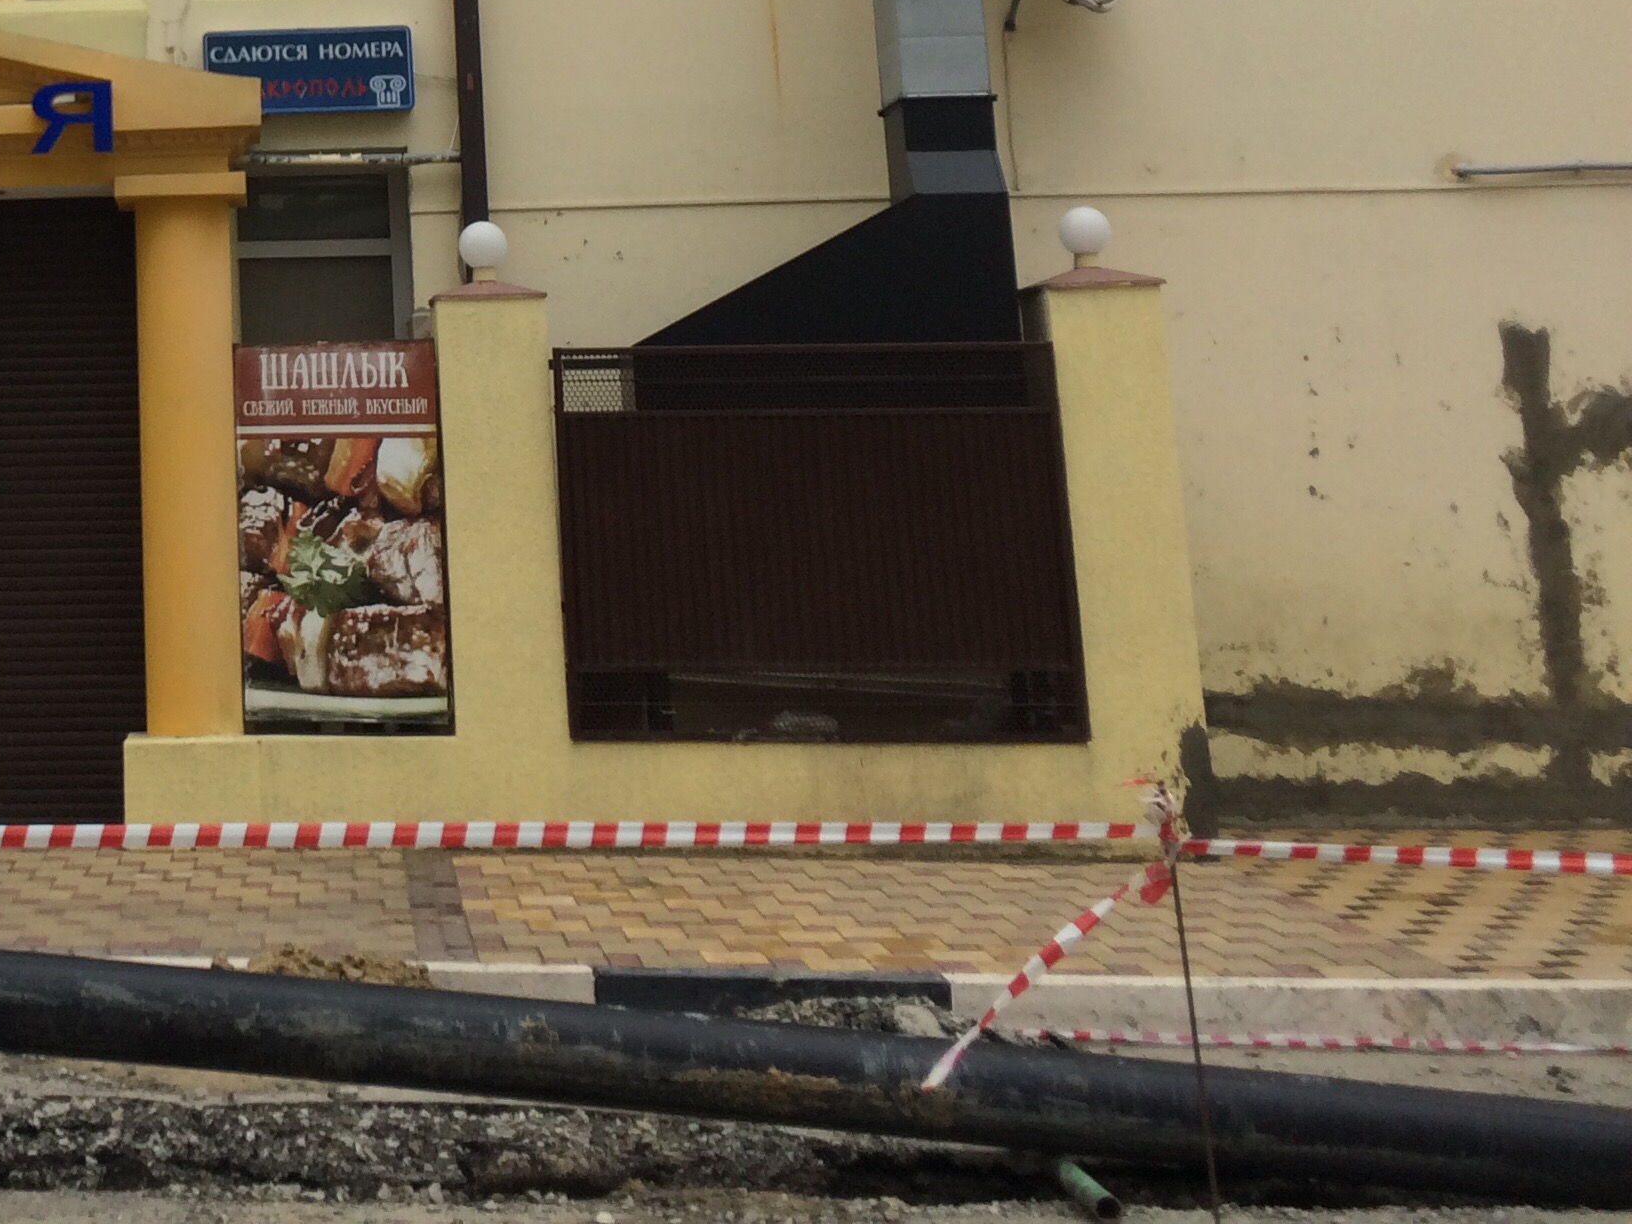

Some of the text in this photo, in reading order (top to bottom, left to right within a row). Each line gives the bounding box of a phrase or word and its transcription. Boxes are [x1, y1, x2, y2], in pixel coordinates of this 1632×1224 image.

[209, 40, 405, 64] СДАЮТСЯ НОМЕРА
[261, 77, 367, 99] КРОПОЛЬ
[259, 351, 409, 390] ШАШЛЫК
